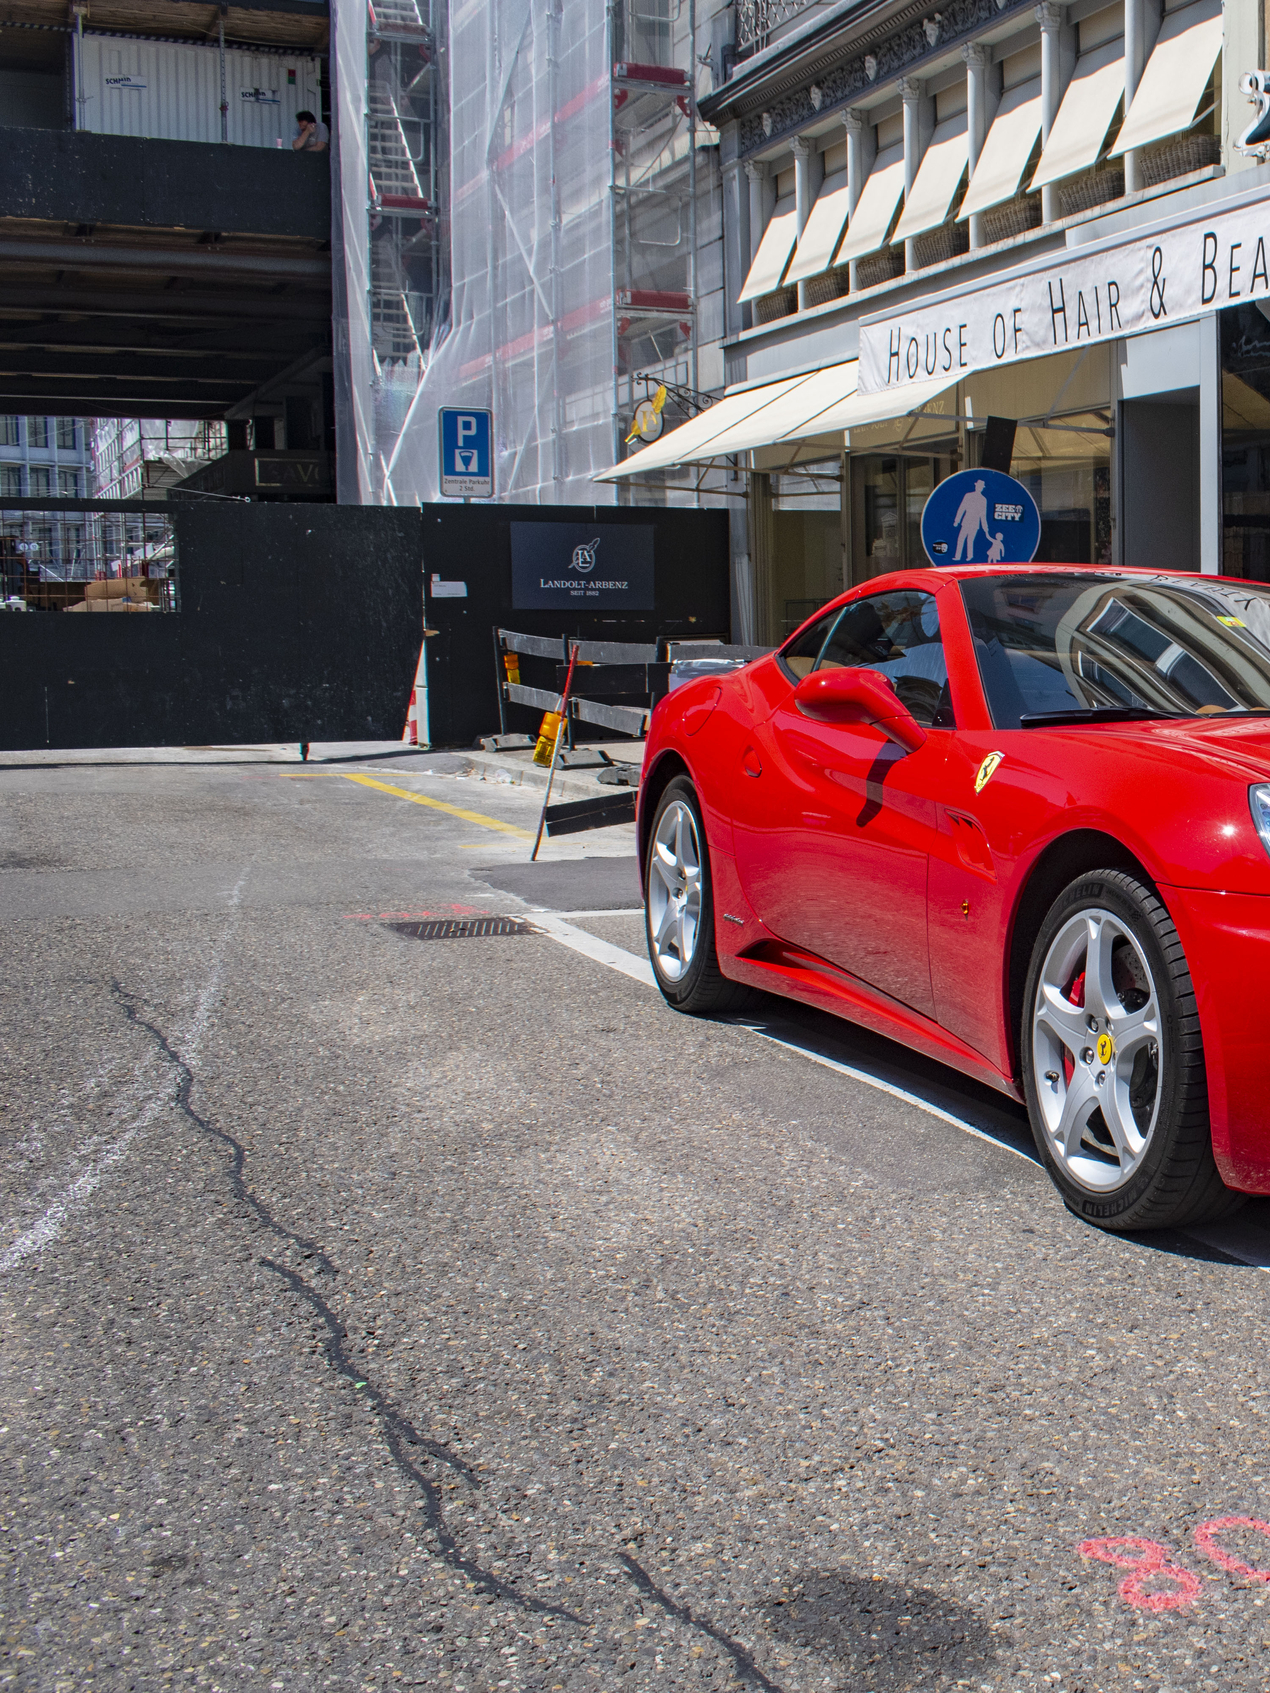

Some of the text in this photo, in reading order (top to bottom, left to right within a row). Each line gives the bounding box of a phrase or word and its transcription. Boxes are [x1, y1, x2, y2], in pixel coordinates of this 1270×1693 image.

[886, 323, 969, 385] HOUSE
[992, 307, 1024, 360] OF
[1047, 277, 1122, 348] HAIR
[1148, 245, 1169, 320] &
[457, 415, 477, 447] P
[995, 503, 1015, 513] ZEE
[994, 512, 1022, 521] CITY
[540, 578, 629, 589] LANDOLT-ARBENZ
